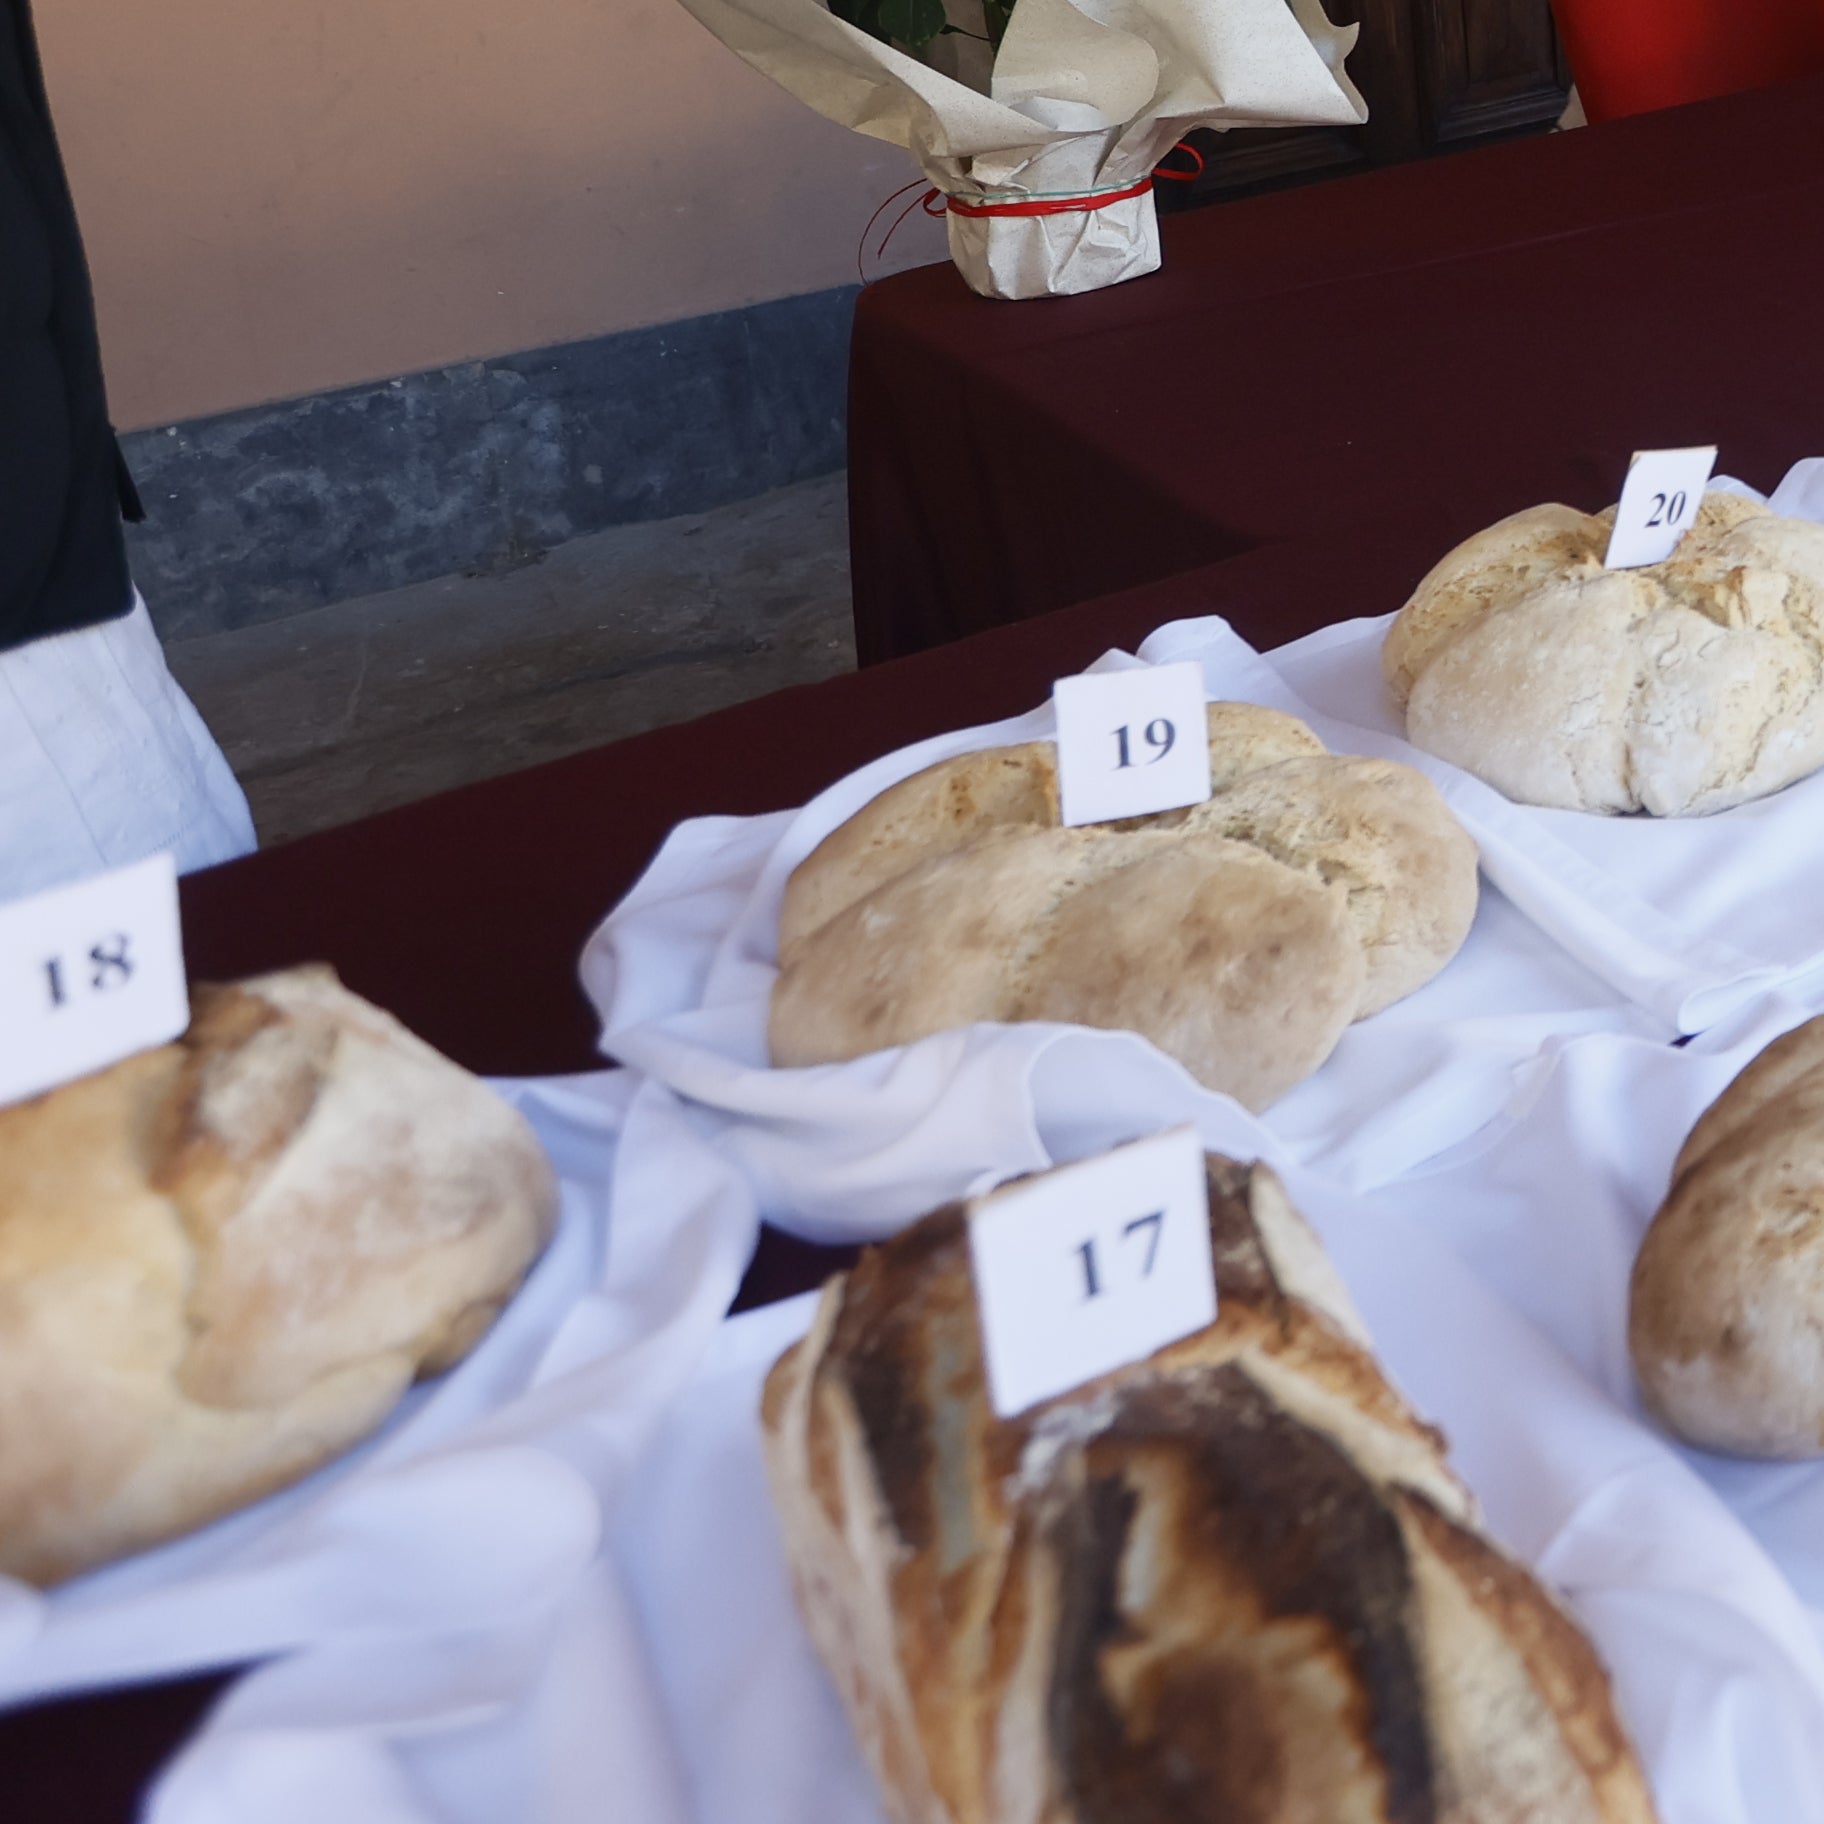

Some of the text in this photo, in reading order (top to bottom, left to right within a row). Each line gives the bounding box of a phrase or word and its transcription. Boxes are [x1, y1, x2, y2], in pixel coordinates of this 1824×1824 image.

[1644, 490, 1687, 528] 20
[1109, 717, 1177, 772] 19
[40, 931, 135, 1011] 18
[1074, 1205, 1168, 1304] 17
